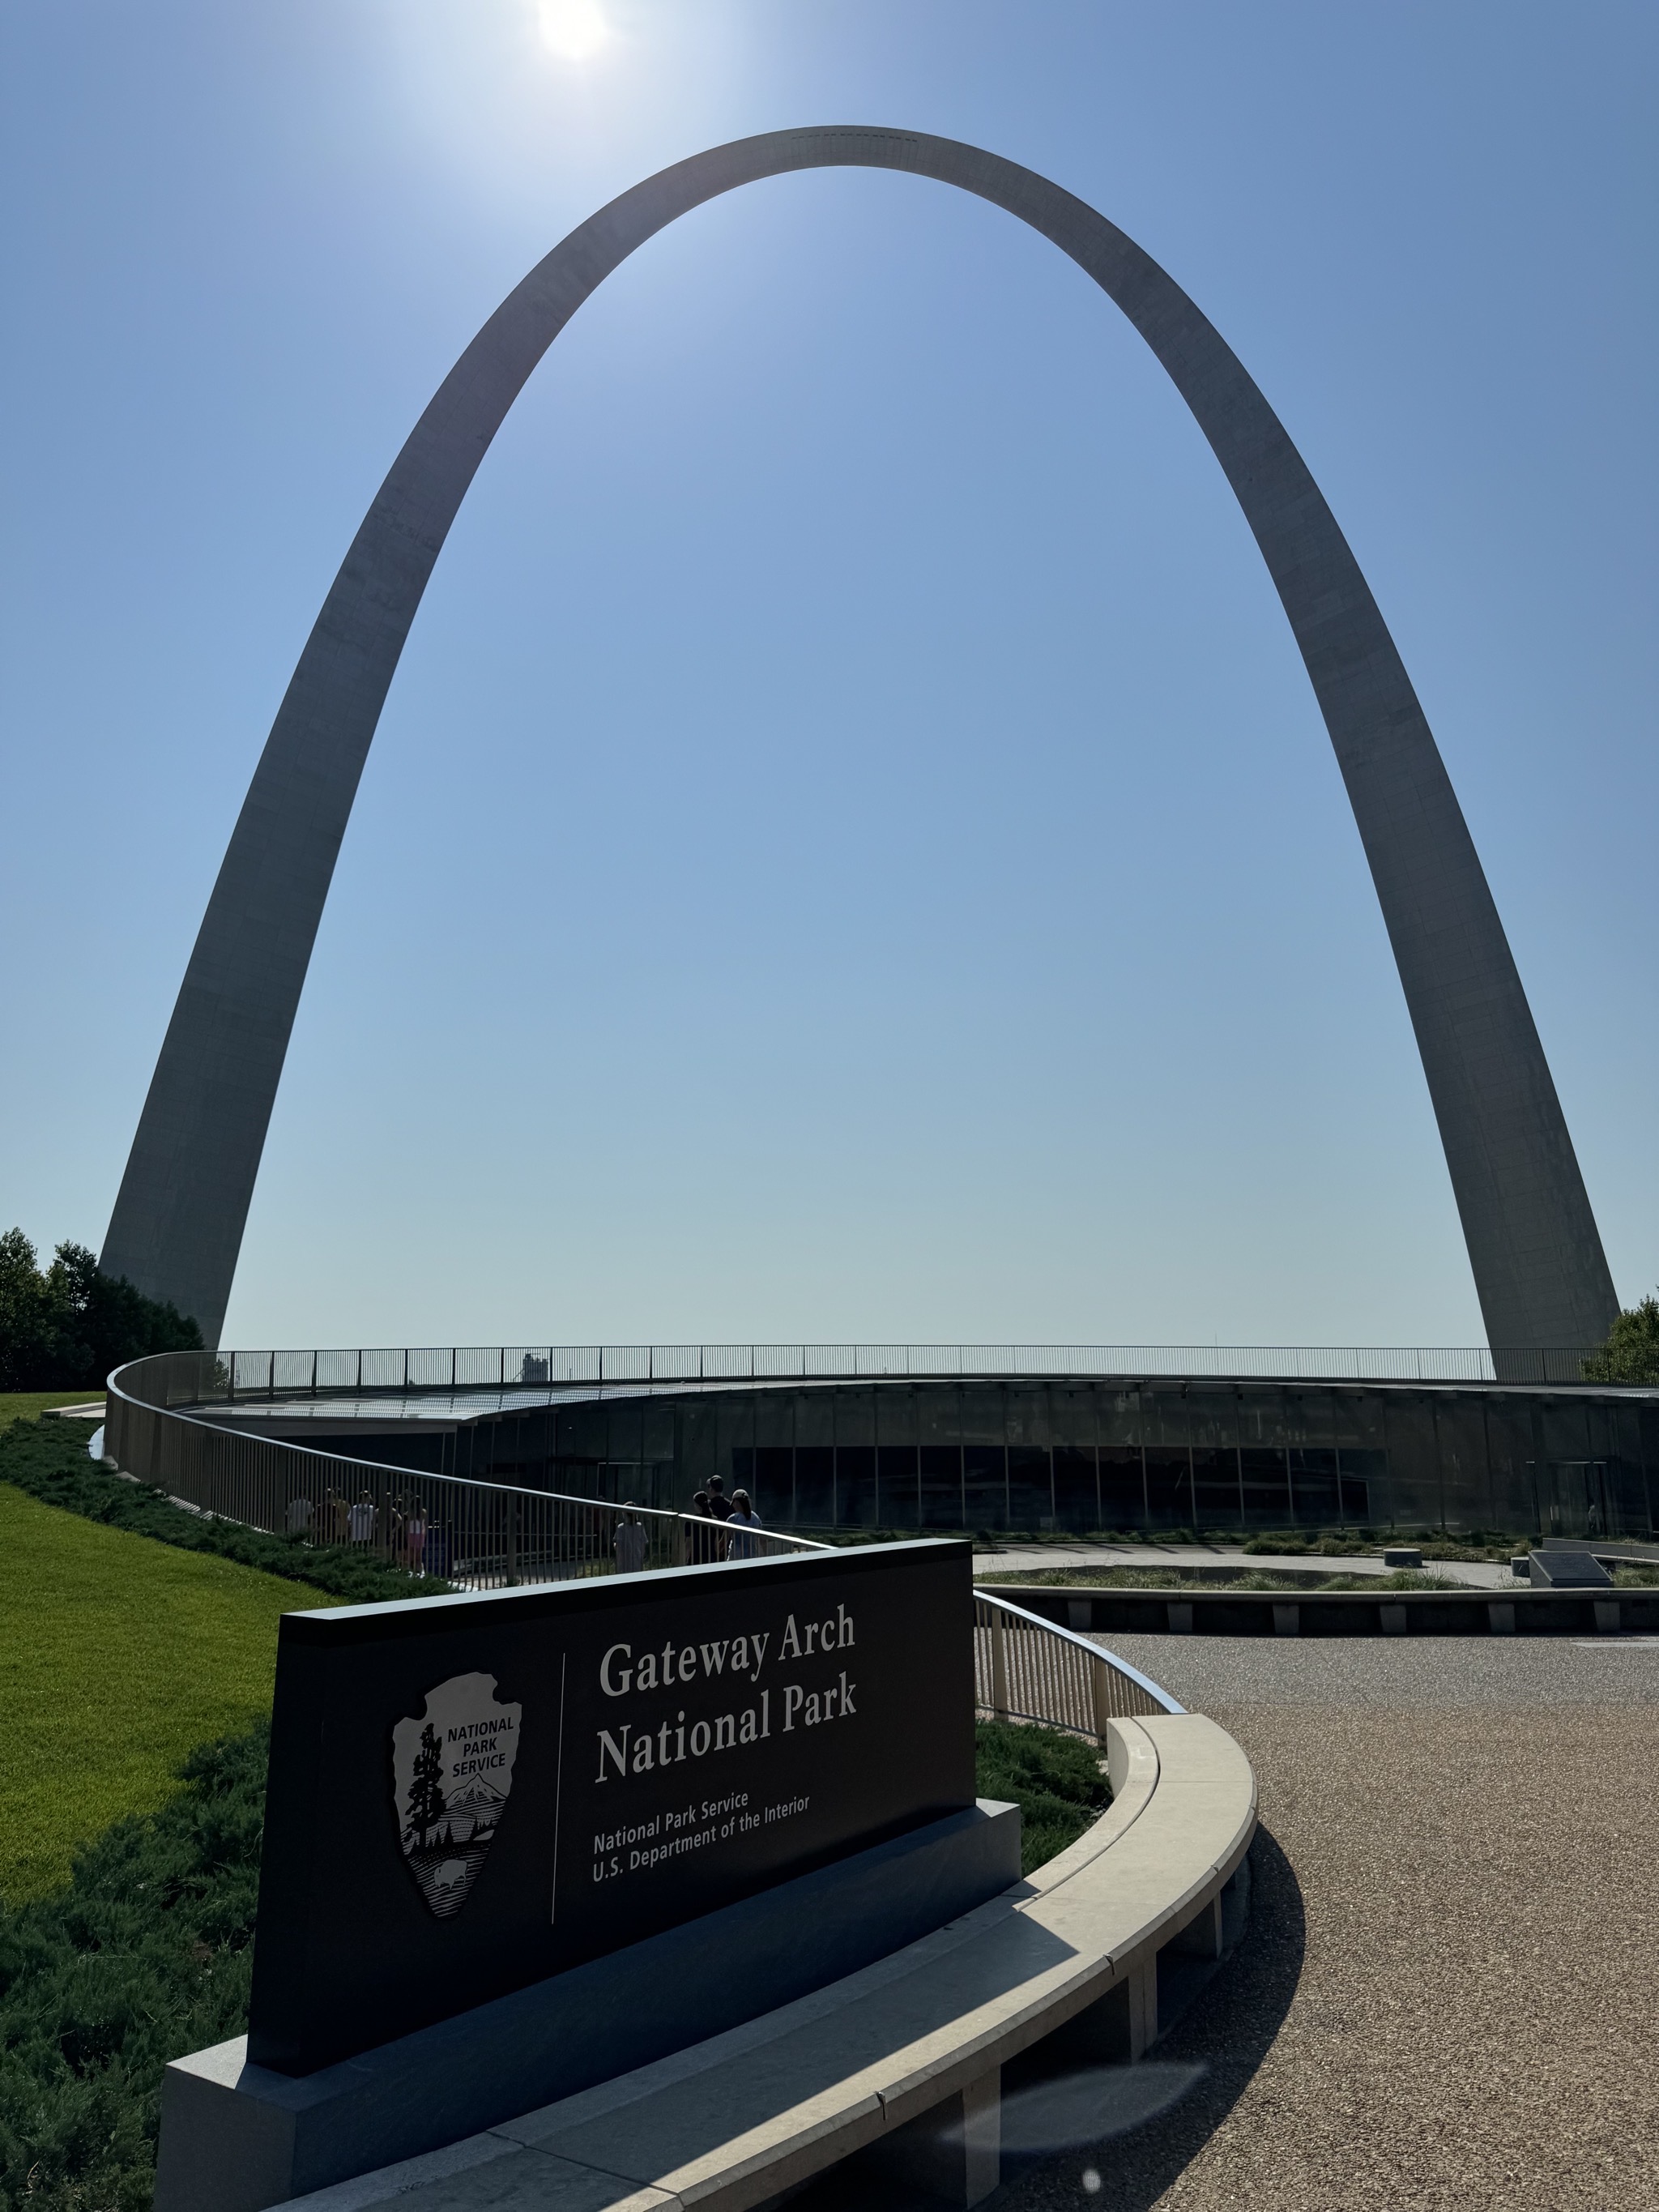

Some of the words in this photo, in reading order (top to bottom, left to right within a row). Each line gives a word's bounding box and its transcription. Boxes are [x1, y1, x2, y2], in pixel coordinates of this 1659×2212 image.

[599, 1632, 770, 1697] Gateway
[778, 1603, 855, 1661] Arch
[447, 1717, 514, 1743] NATIONAL
[463, 1737, 497, 1757] PARK
[595, 1689, 771, 1783] National
[783, 1671, 858, 1732] Park
[452, 1753, 506, 1778] SERVICE
[593, 1856, 624, 1882] U.S.
[629, 1823, 717, 1870] Department
[721, 1816, 736, 1838] of
[739, 1812, 761, 1832] the
[765, 1796, 810, 1824] Interior
[594, 1814, 660, 1855] National
[665, 1804, 697, 1831] Park
[701, 1791, 748, 1820] Service
